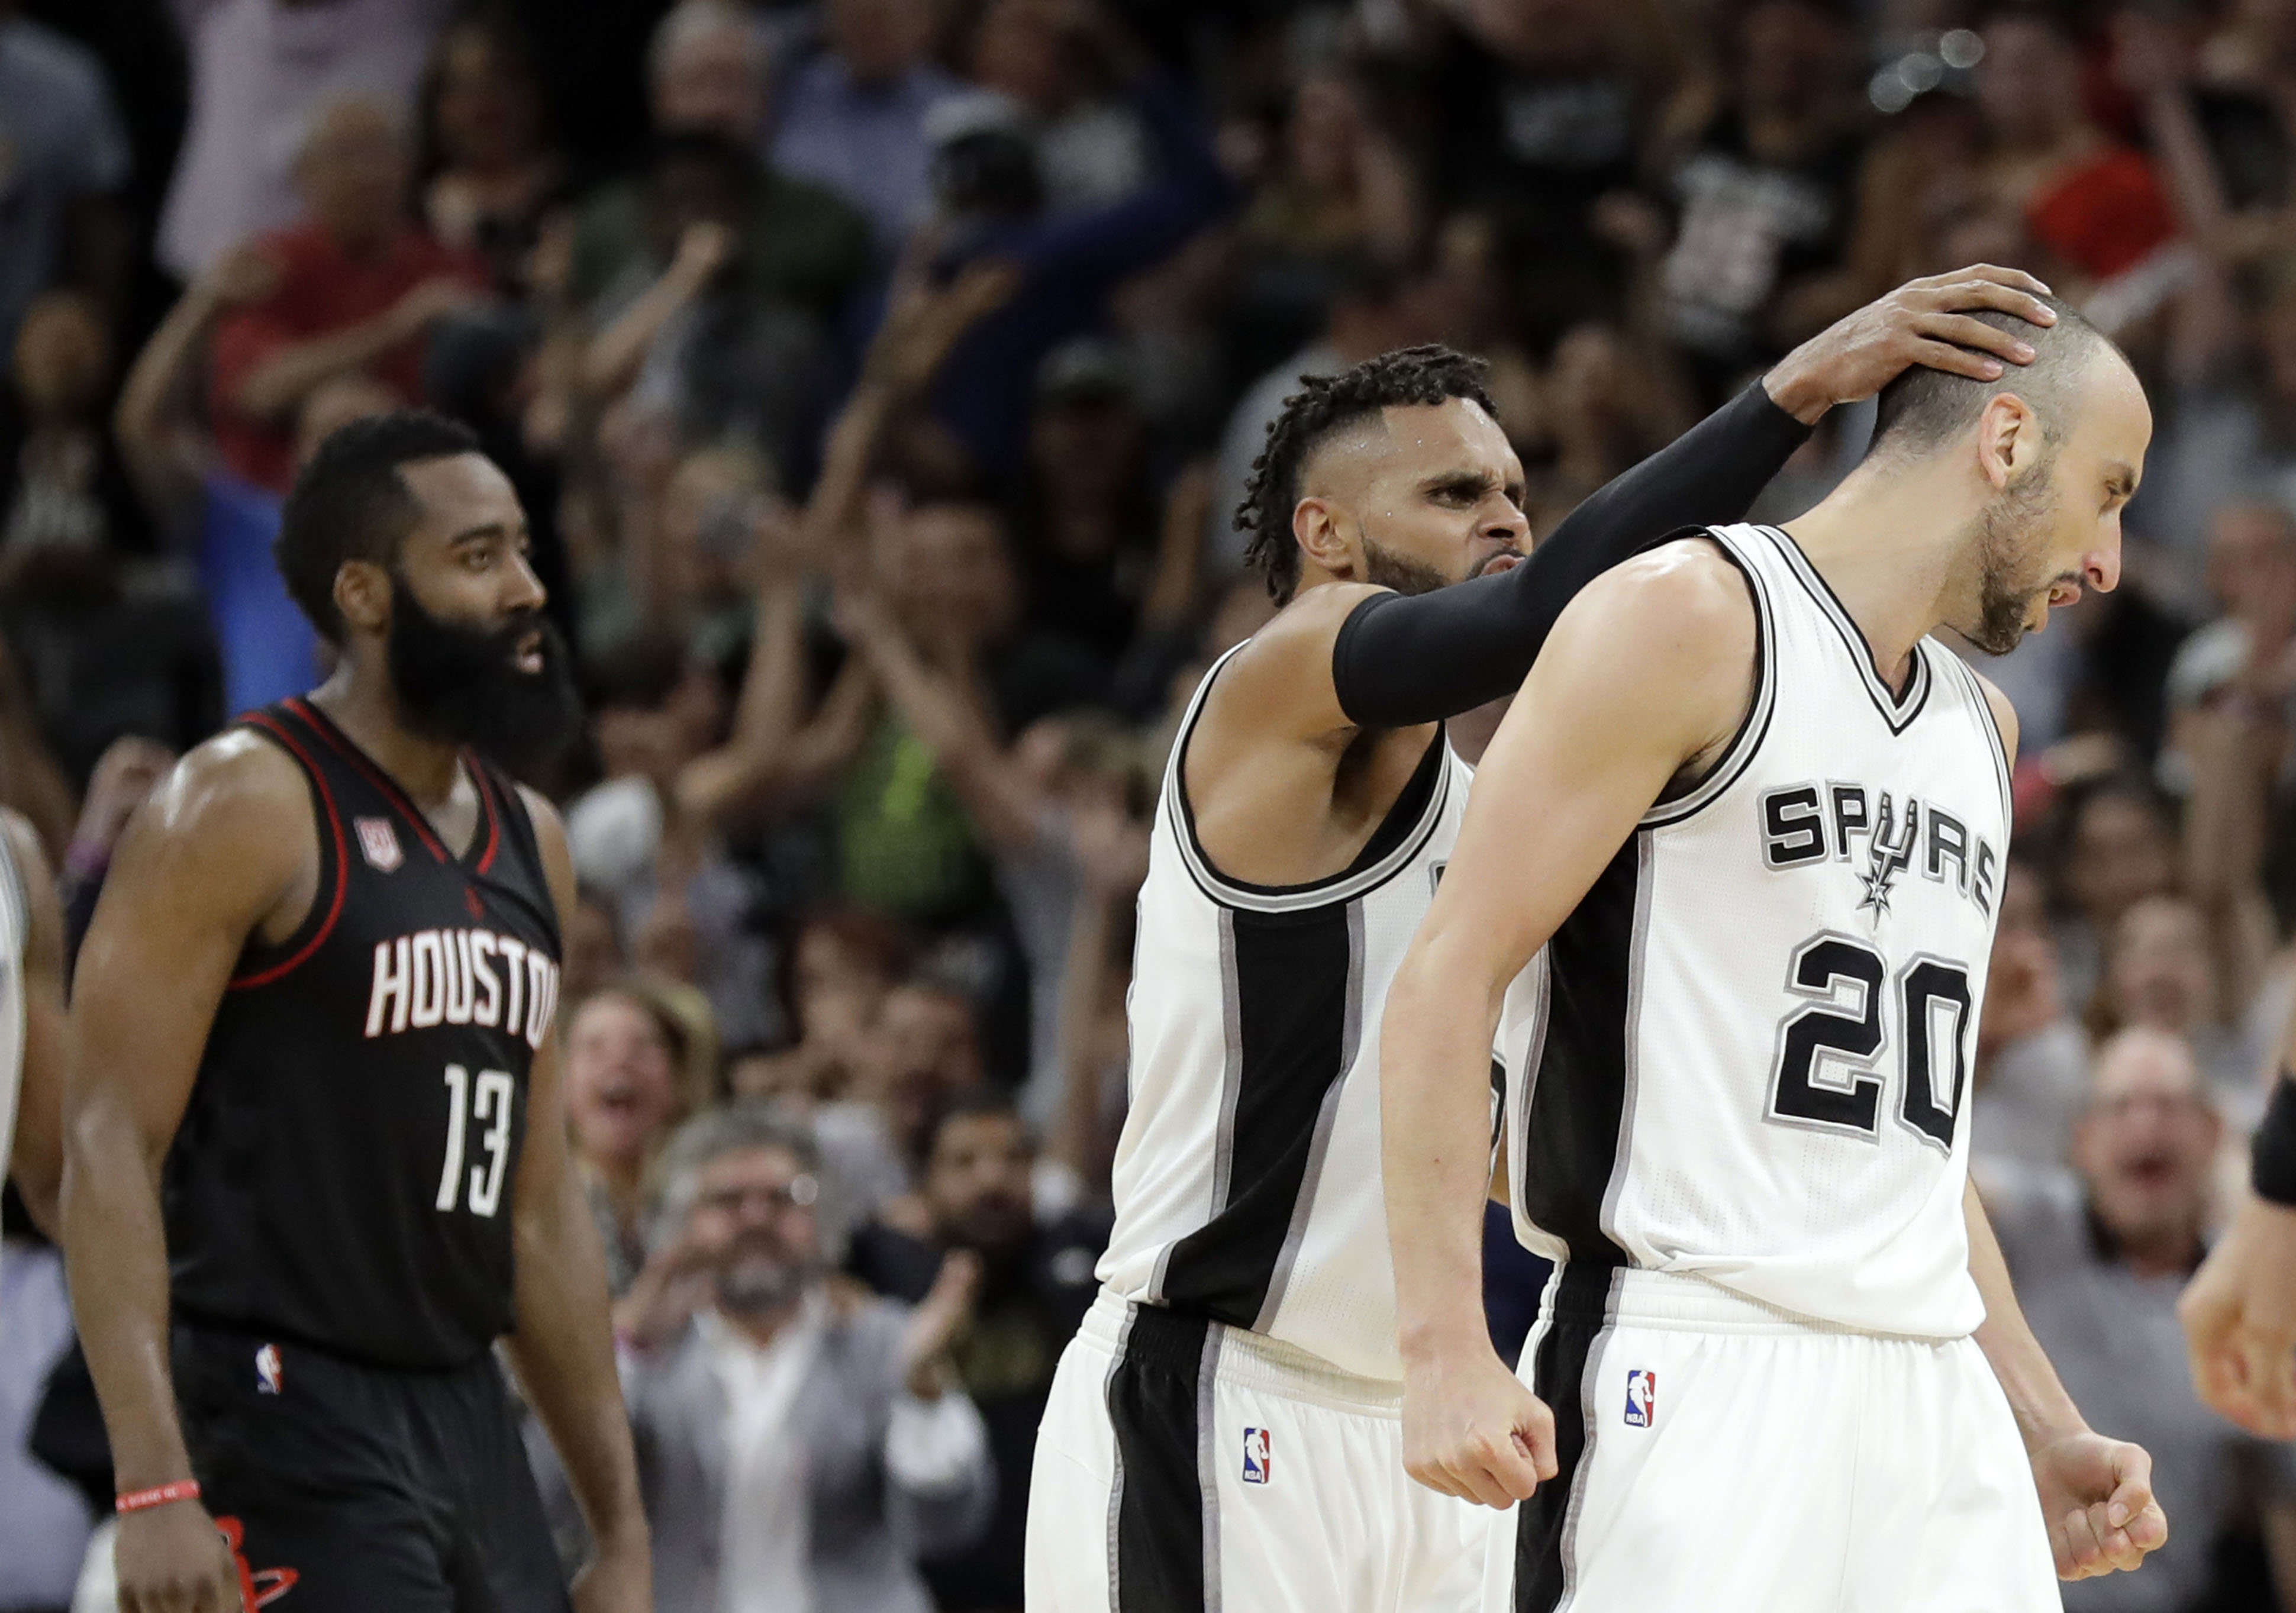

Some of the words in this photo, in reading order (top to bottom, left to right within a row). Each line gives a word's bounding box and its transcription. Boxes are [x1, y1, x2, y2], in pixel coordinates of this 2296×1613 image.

[365, 927, 560, 1050] HOUSTO
[1762, 929, 1973, 1160] 20
[436, 1063, 515, 1218] 13
